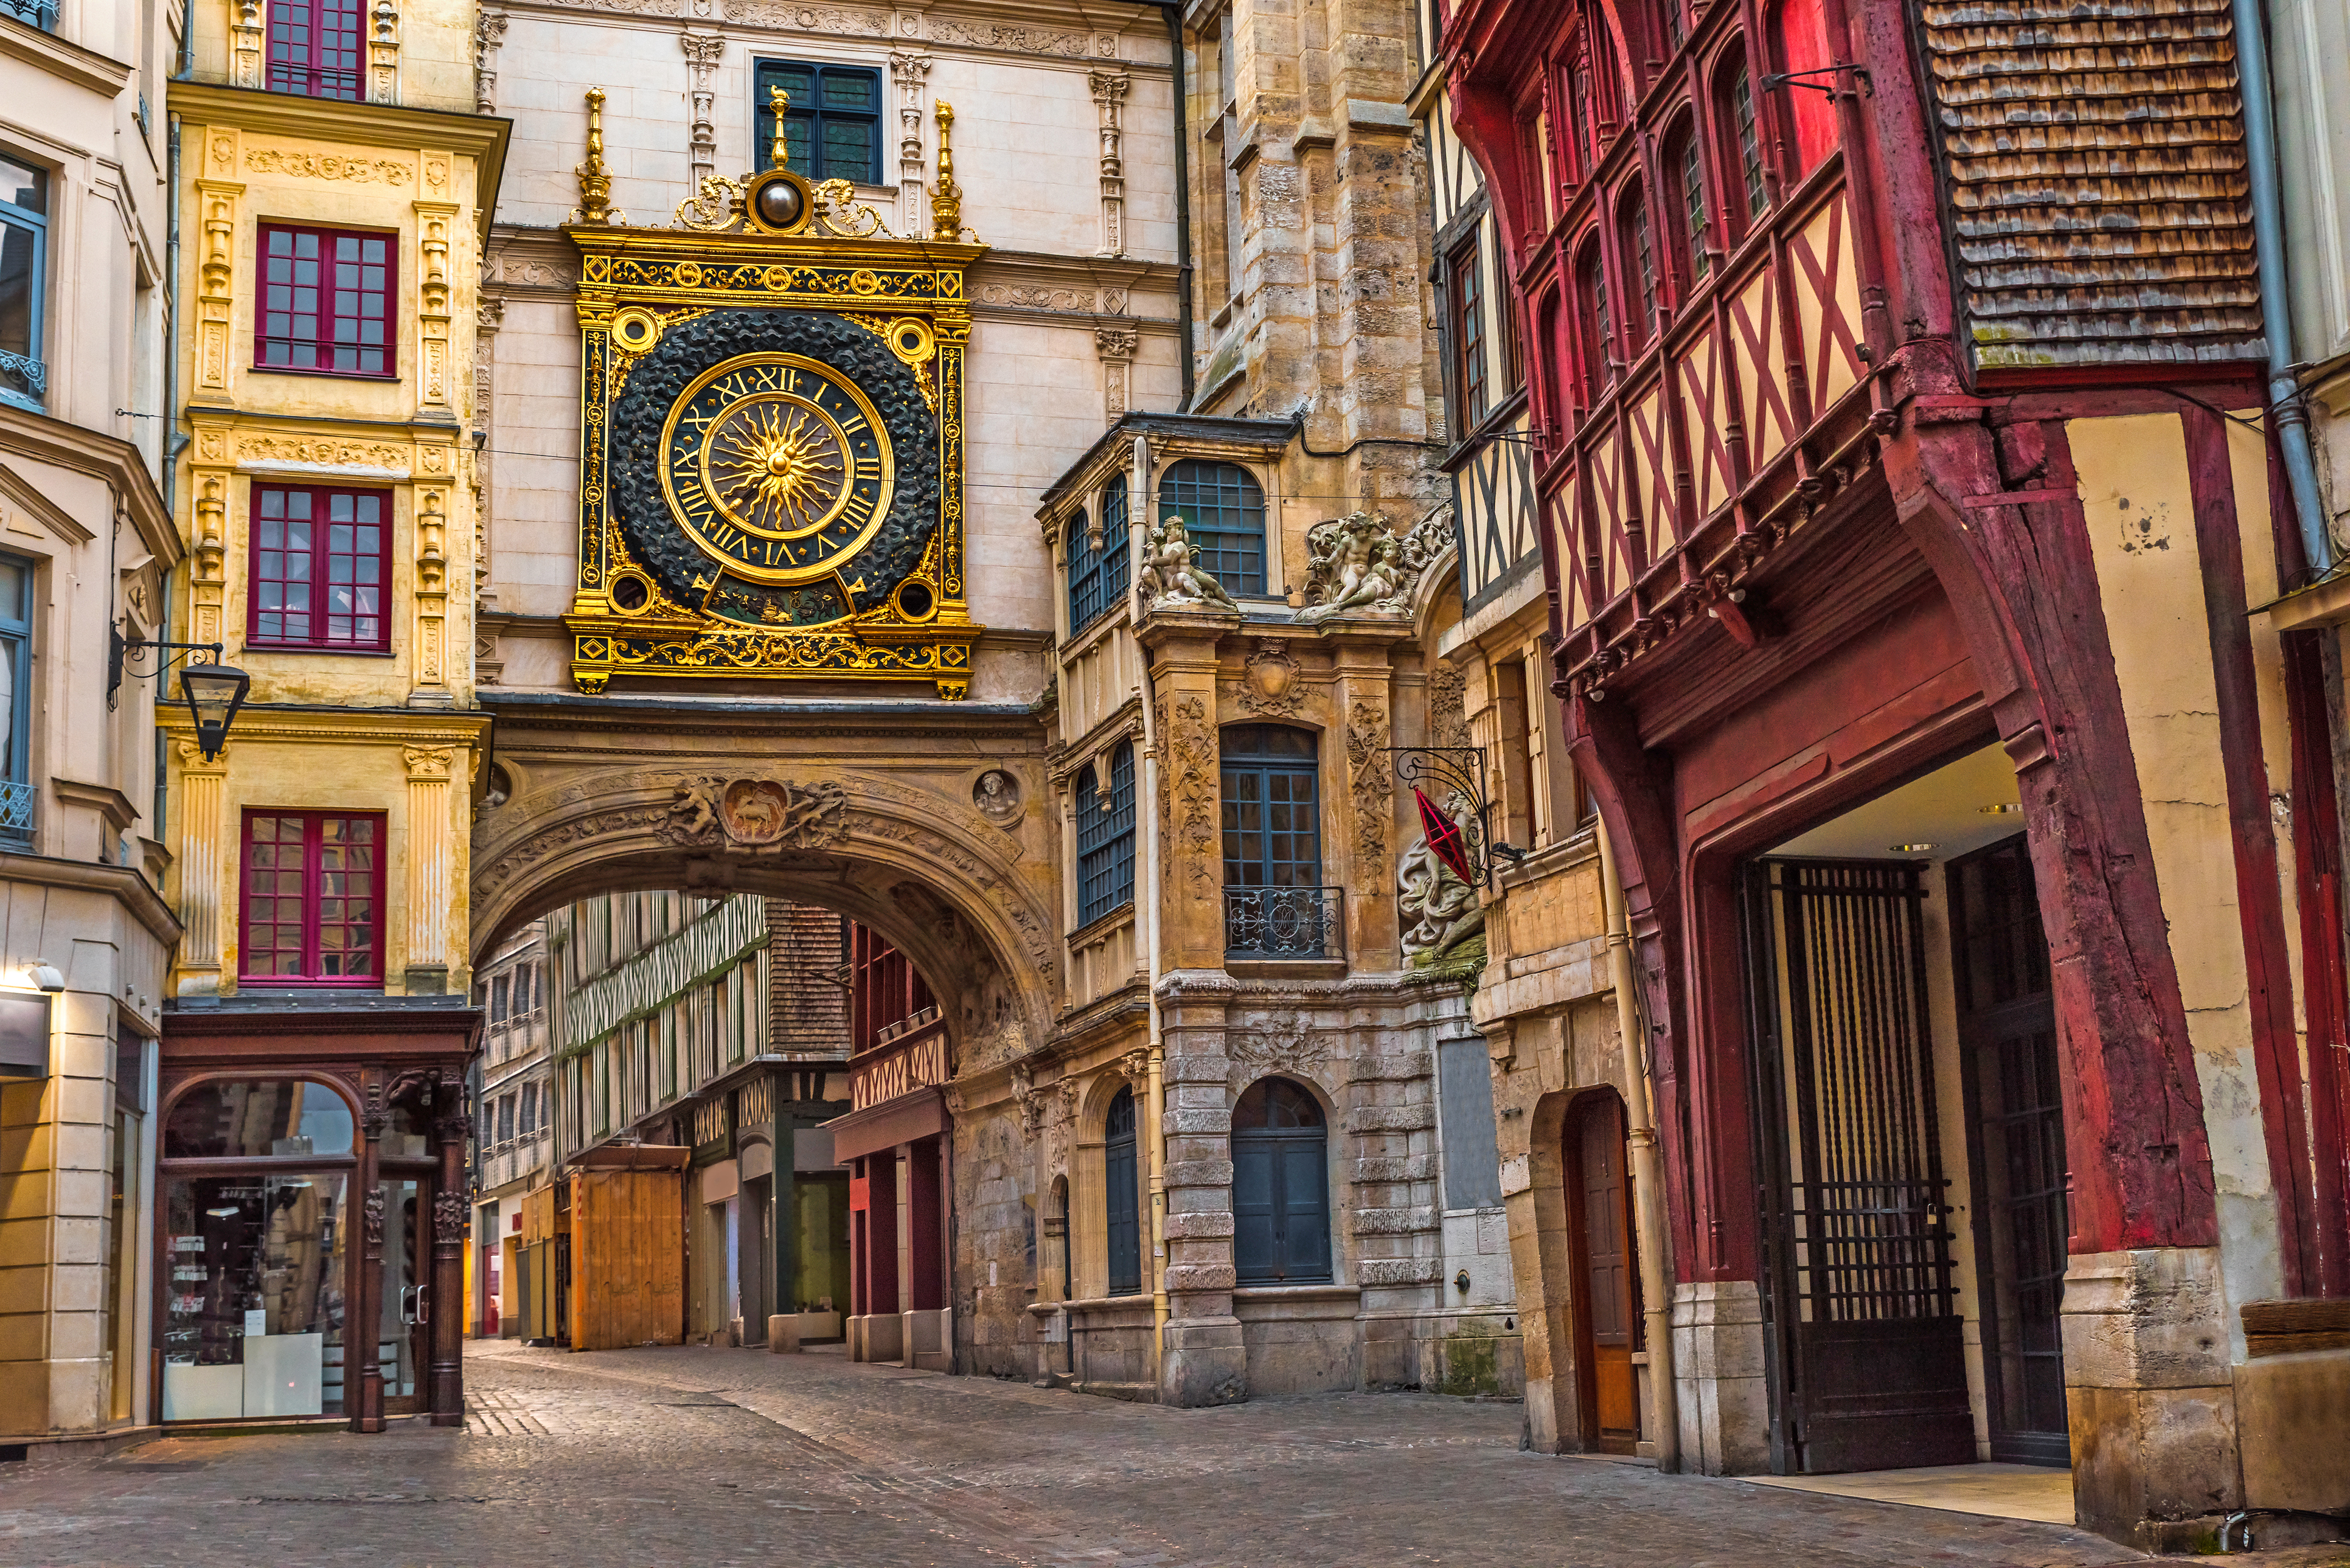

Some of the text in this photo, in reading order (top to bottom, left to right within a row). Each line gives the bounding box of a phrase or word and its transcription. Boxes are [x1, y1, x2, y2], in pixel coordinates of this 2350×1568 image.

[710, 372, 749, 406] XI
[754, 367, 796, 392] XII
[813, 381, 829, 403] I
[682, 404, 714, 435] X
[841, 413, 867, 436] II
[673, 446, 699, 478] IX
[856, 456, 880, 481] III
[678, 483, 715, 534] VIII
[839, 493, 874, 532] IIII
[711, 522, 749, 560] VII
[764, 541, 798, 566] VI
[818, 533, 840, 558] V
